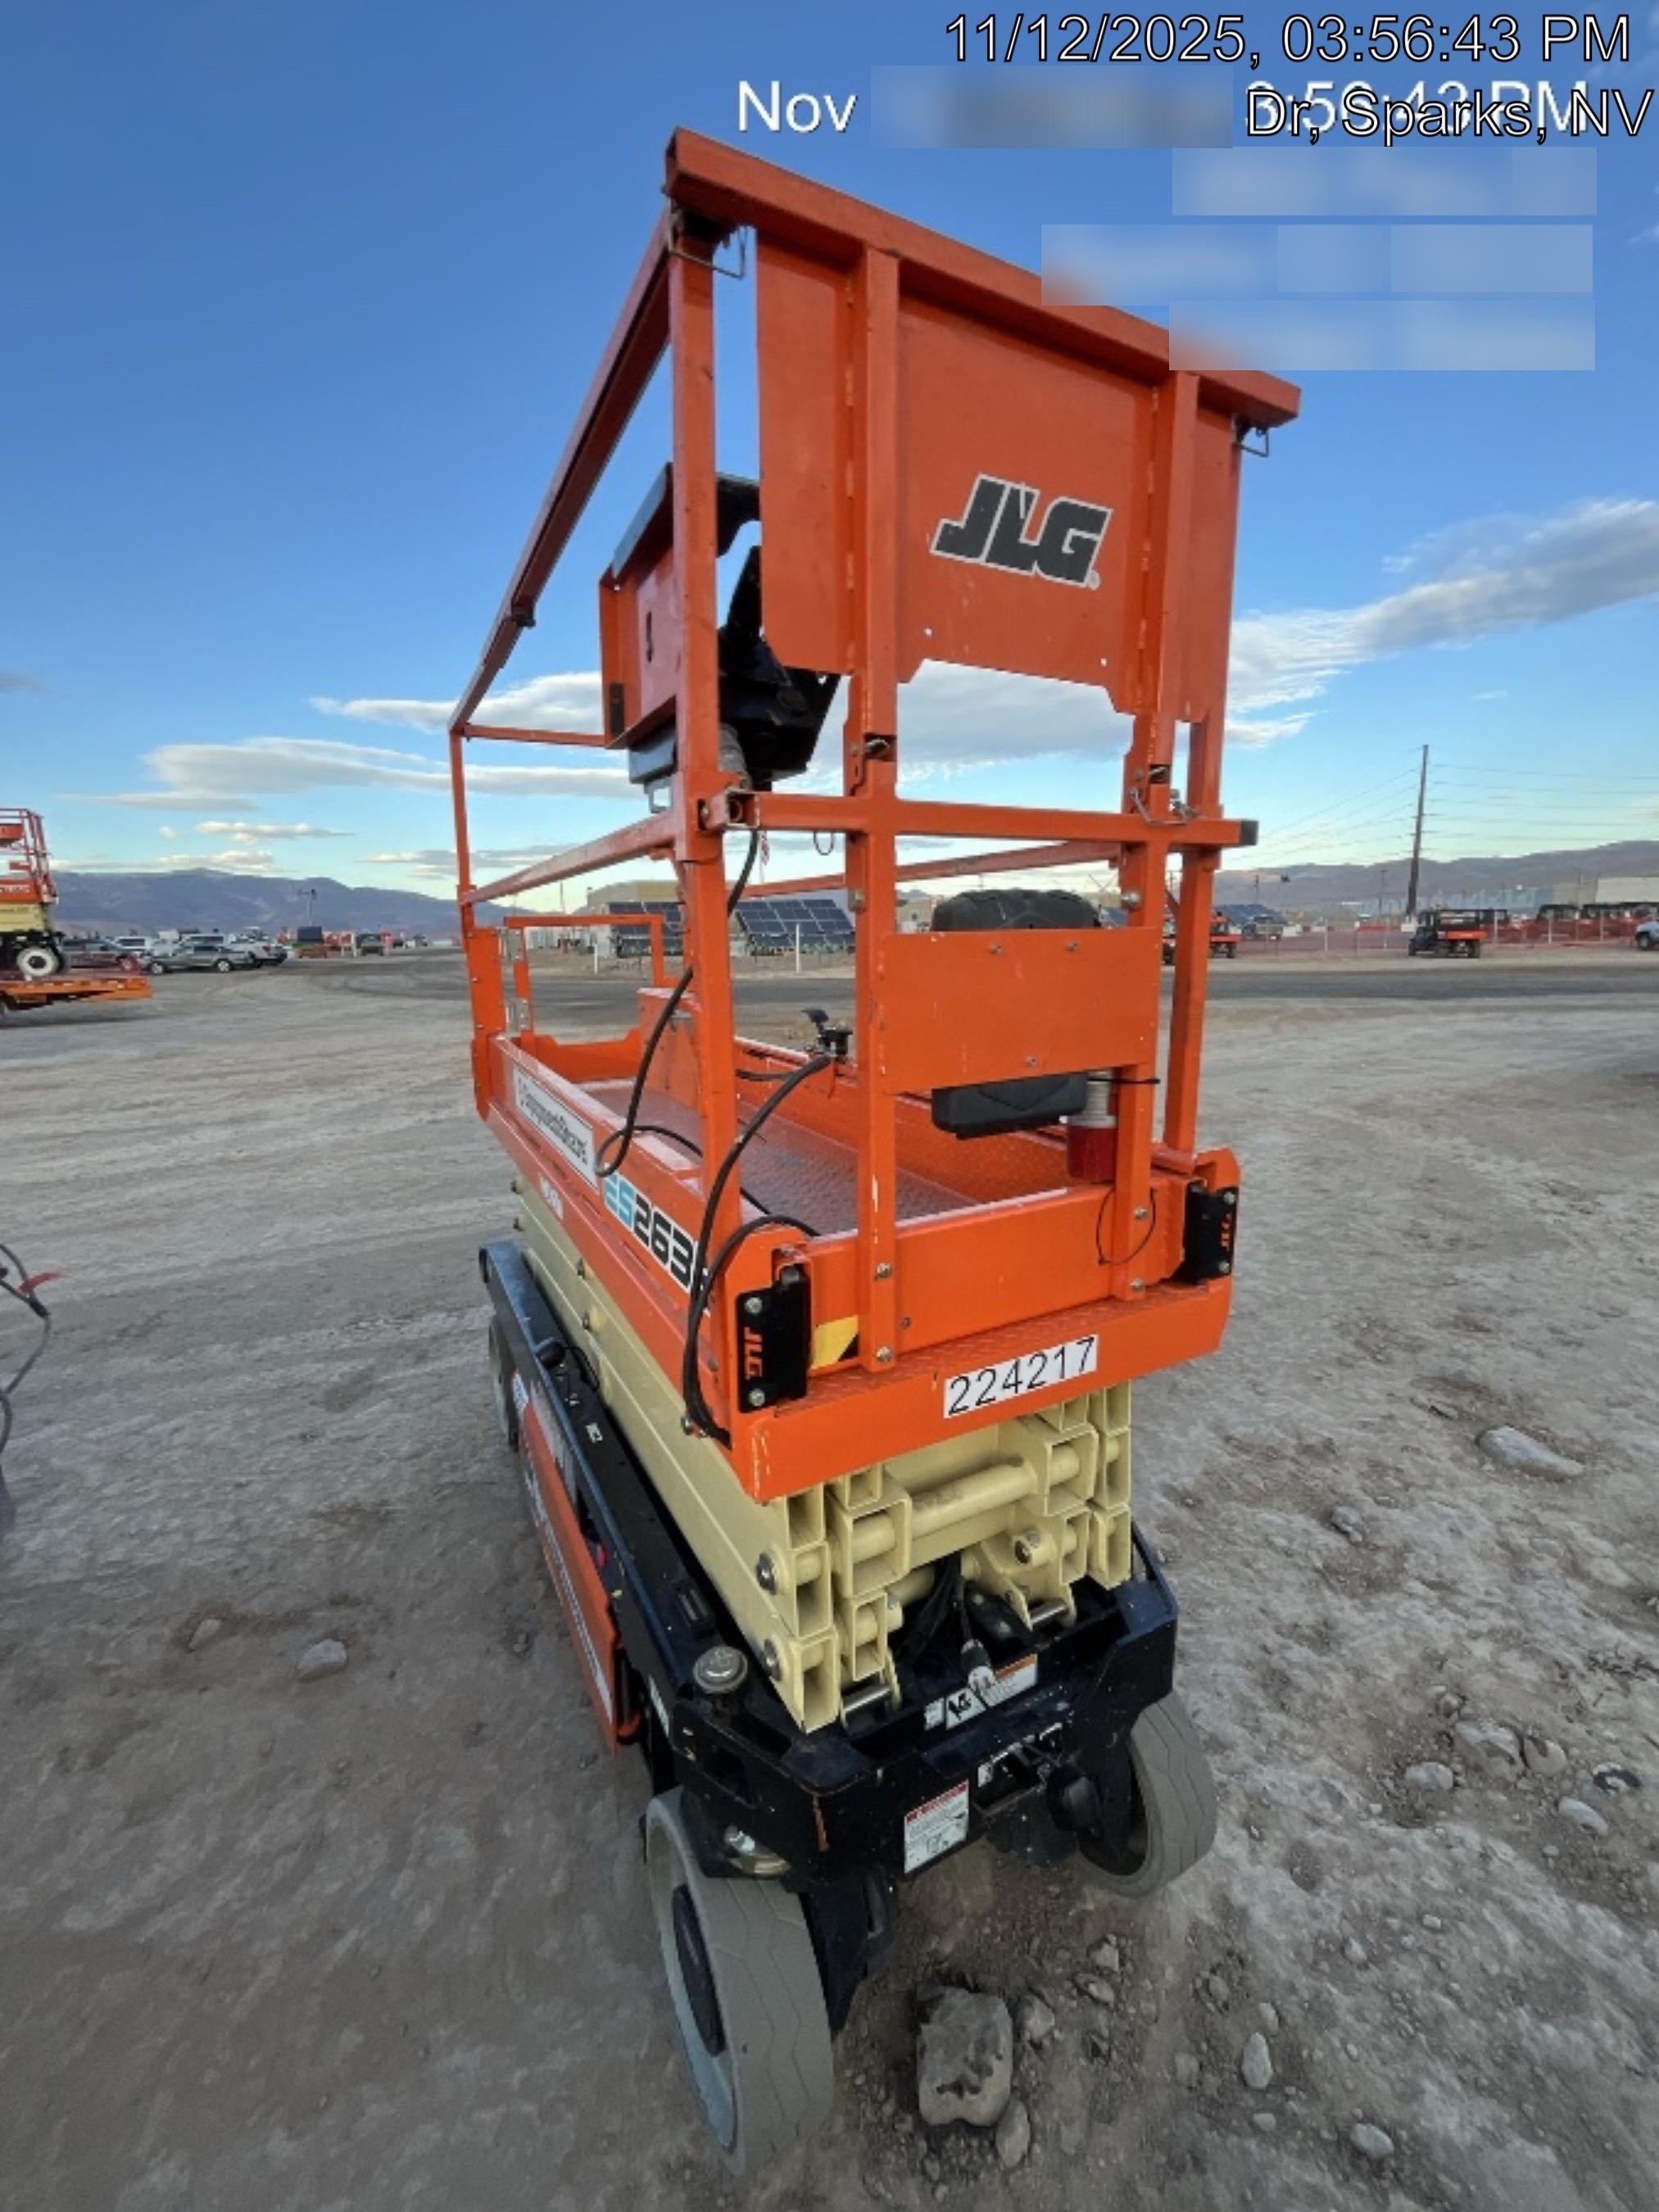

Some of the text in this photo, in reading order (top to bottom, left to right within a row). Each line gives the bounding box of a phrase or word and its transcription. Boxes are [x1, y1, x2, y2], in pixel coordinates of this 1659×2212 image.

[930, 473, 1113, 589] JLG
[744, 1326, 763, 1380] JLG
[948, 1336, 1095, 1416] 224217
